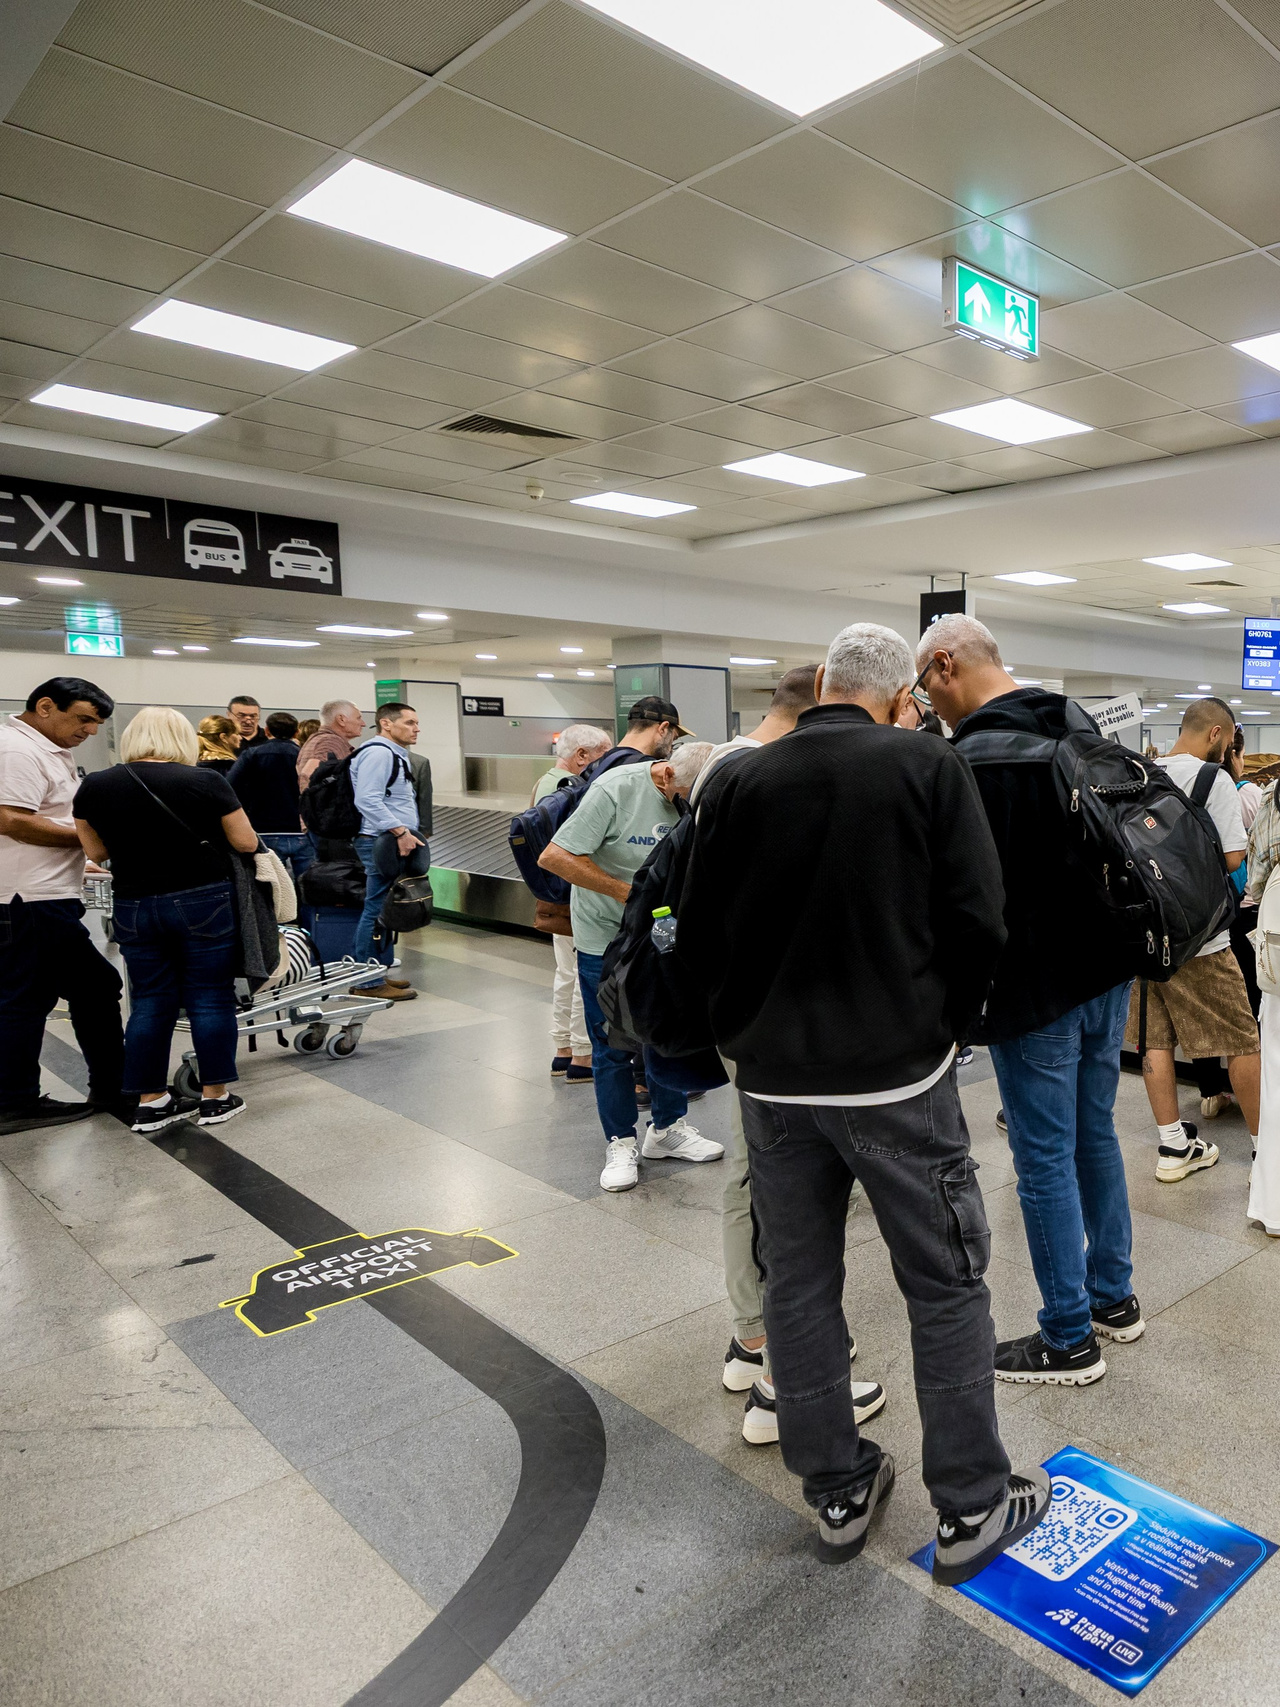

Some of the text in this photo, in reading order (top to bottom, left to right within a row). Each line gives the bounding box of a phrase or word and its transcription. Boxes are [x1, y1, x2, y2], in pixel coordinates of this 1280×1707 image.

[205, 552, 226, 562] BUS
[1105, 707, 1114, 715] all
[1114, 703, 1127, 712] over
[1108, 711, 1134, 725] Republic
[272, 1236, 425, 1282] OFFICIAL
[286, 1241, 433, 1293] AIRPORT
[331, 1261, 417, 1289] TAXI
[1146, 1540, 1177, 1560] reálném
[1177, 1556, 1195, 1569] čase
[1148, 1531, 1183, 1551] rozšířené
[1182, 1549, 1208, 1564] realitě
[1150, 1521, 1235, 1568] Sledujte letecký provoz
[1087, 1574, 1146, 1610] and in real time
[1095, 1566, 1178, 1616] in Augmented Reality
[1104, 1559, 1164, 1595] Watch air traffic
[1070, 1623, 1137, 1660] Airport LIVE
[1077, 1617, 1115, 1643] Prague
